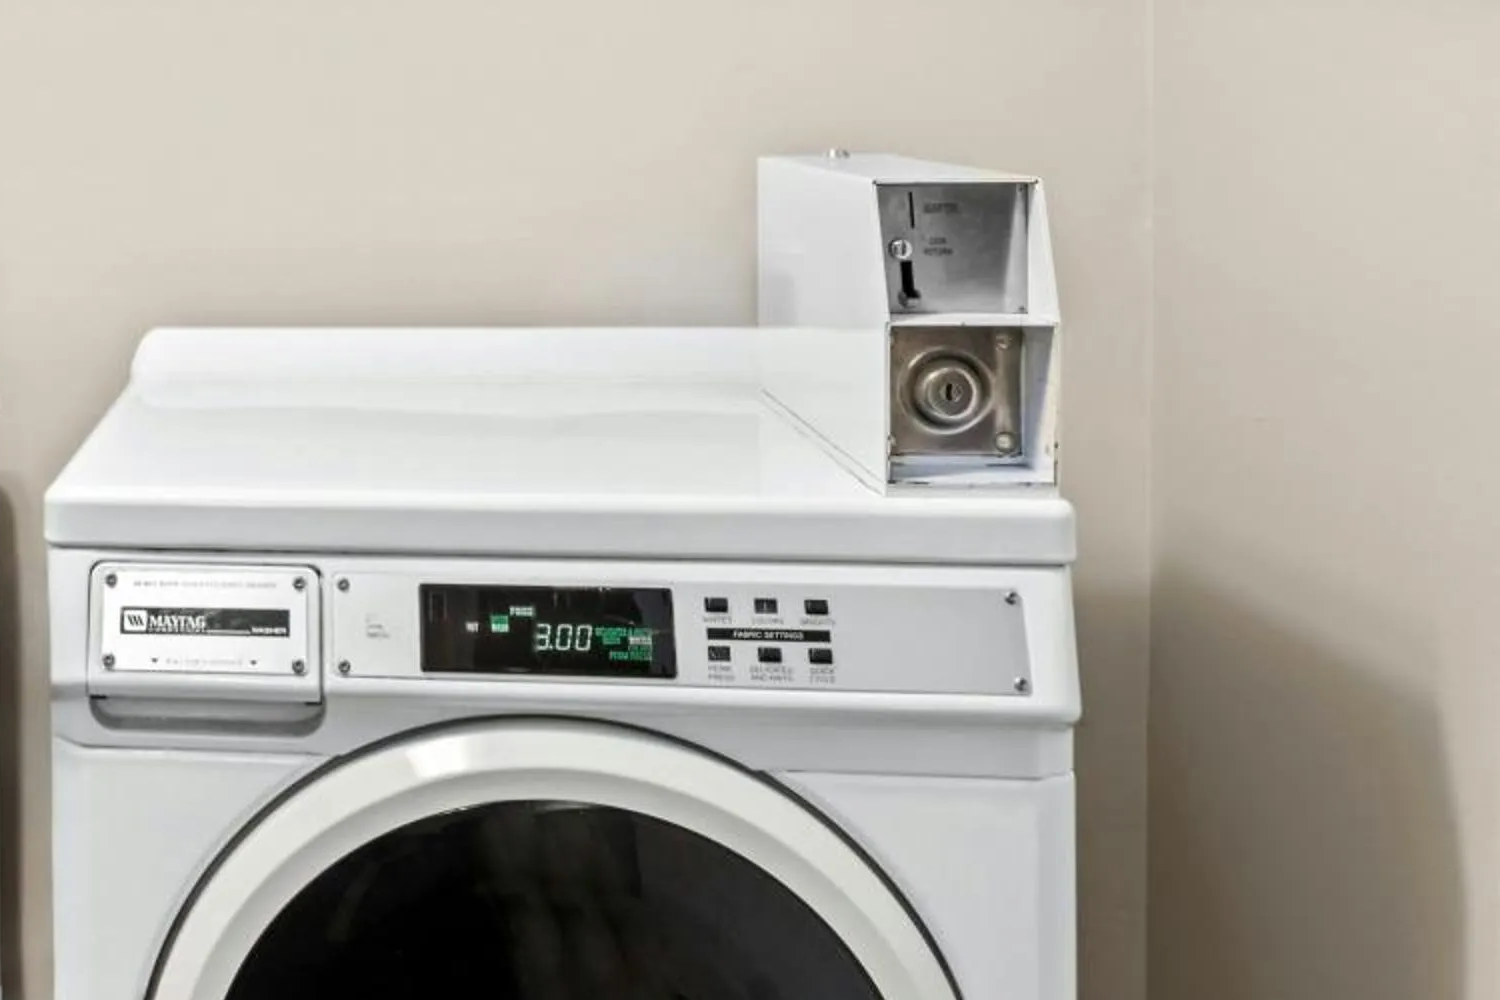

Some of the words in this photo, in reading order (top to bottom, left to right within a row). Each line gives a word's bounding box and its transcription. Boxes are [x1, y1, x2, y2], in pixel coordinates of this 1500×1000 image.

[149, 615, 206, 630] MAYTAG
[536, 623, 592, 651] 3.00
[733, 630, 763, 639] FABRIC
[764, 631, 804, 641] SETTINGS
